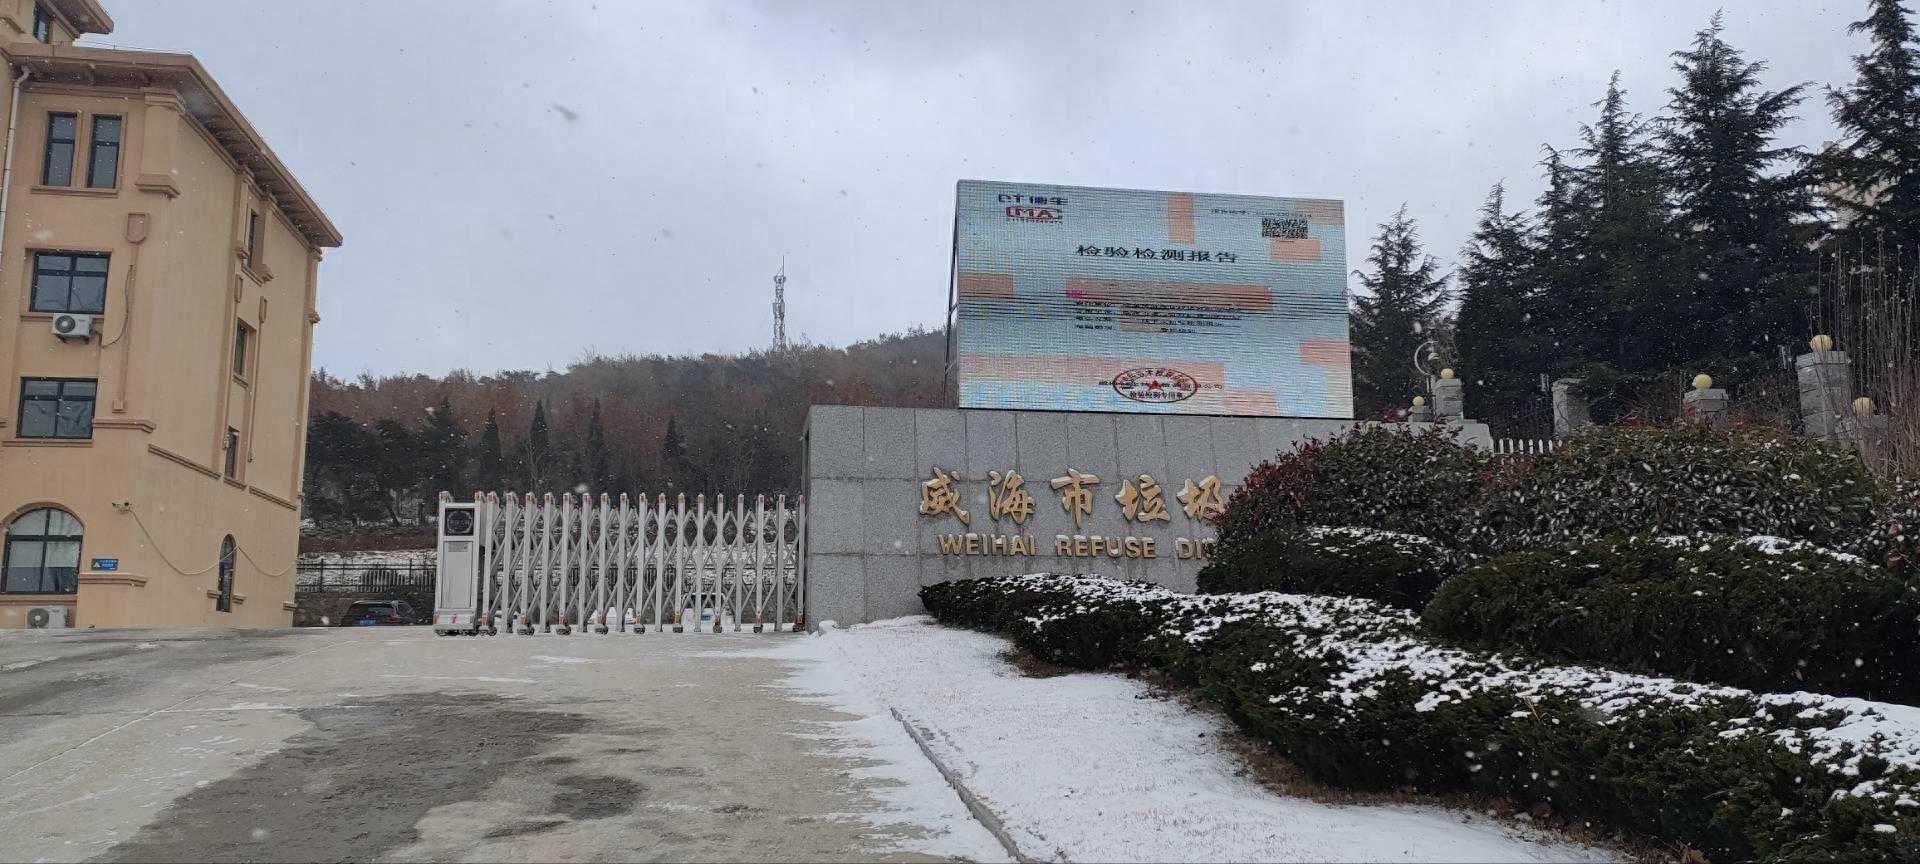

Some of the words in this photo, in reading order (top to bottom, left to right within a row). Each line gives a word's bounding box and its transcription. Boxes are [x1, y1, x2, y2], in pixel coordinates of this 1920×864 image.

[1075, 244, 1240, 264] 检验检测报告
[920, 466, 1226, 530] 威海市垃圾
[938, 533, 1038, 557] WEIHAI
[1055, 534, 1158, 559] REFUSE
